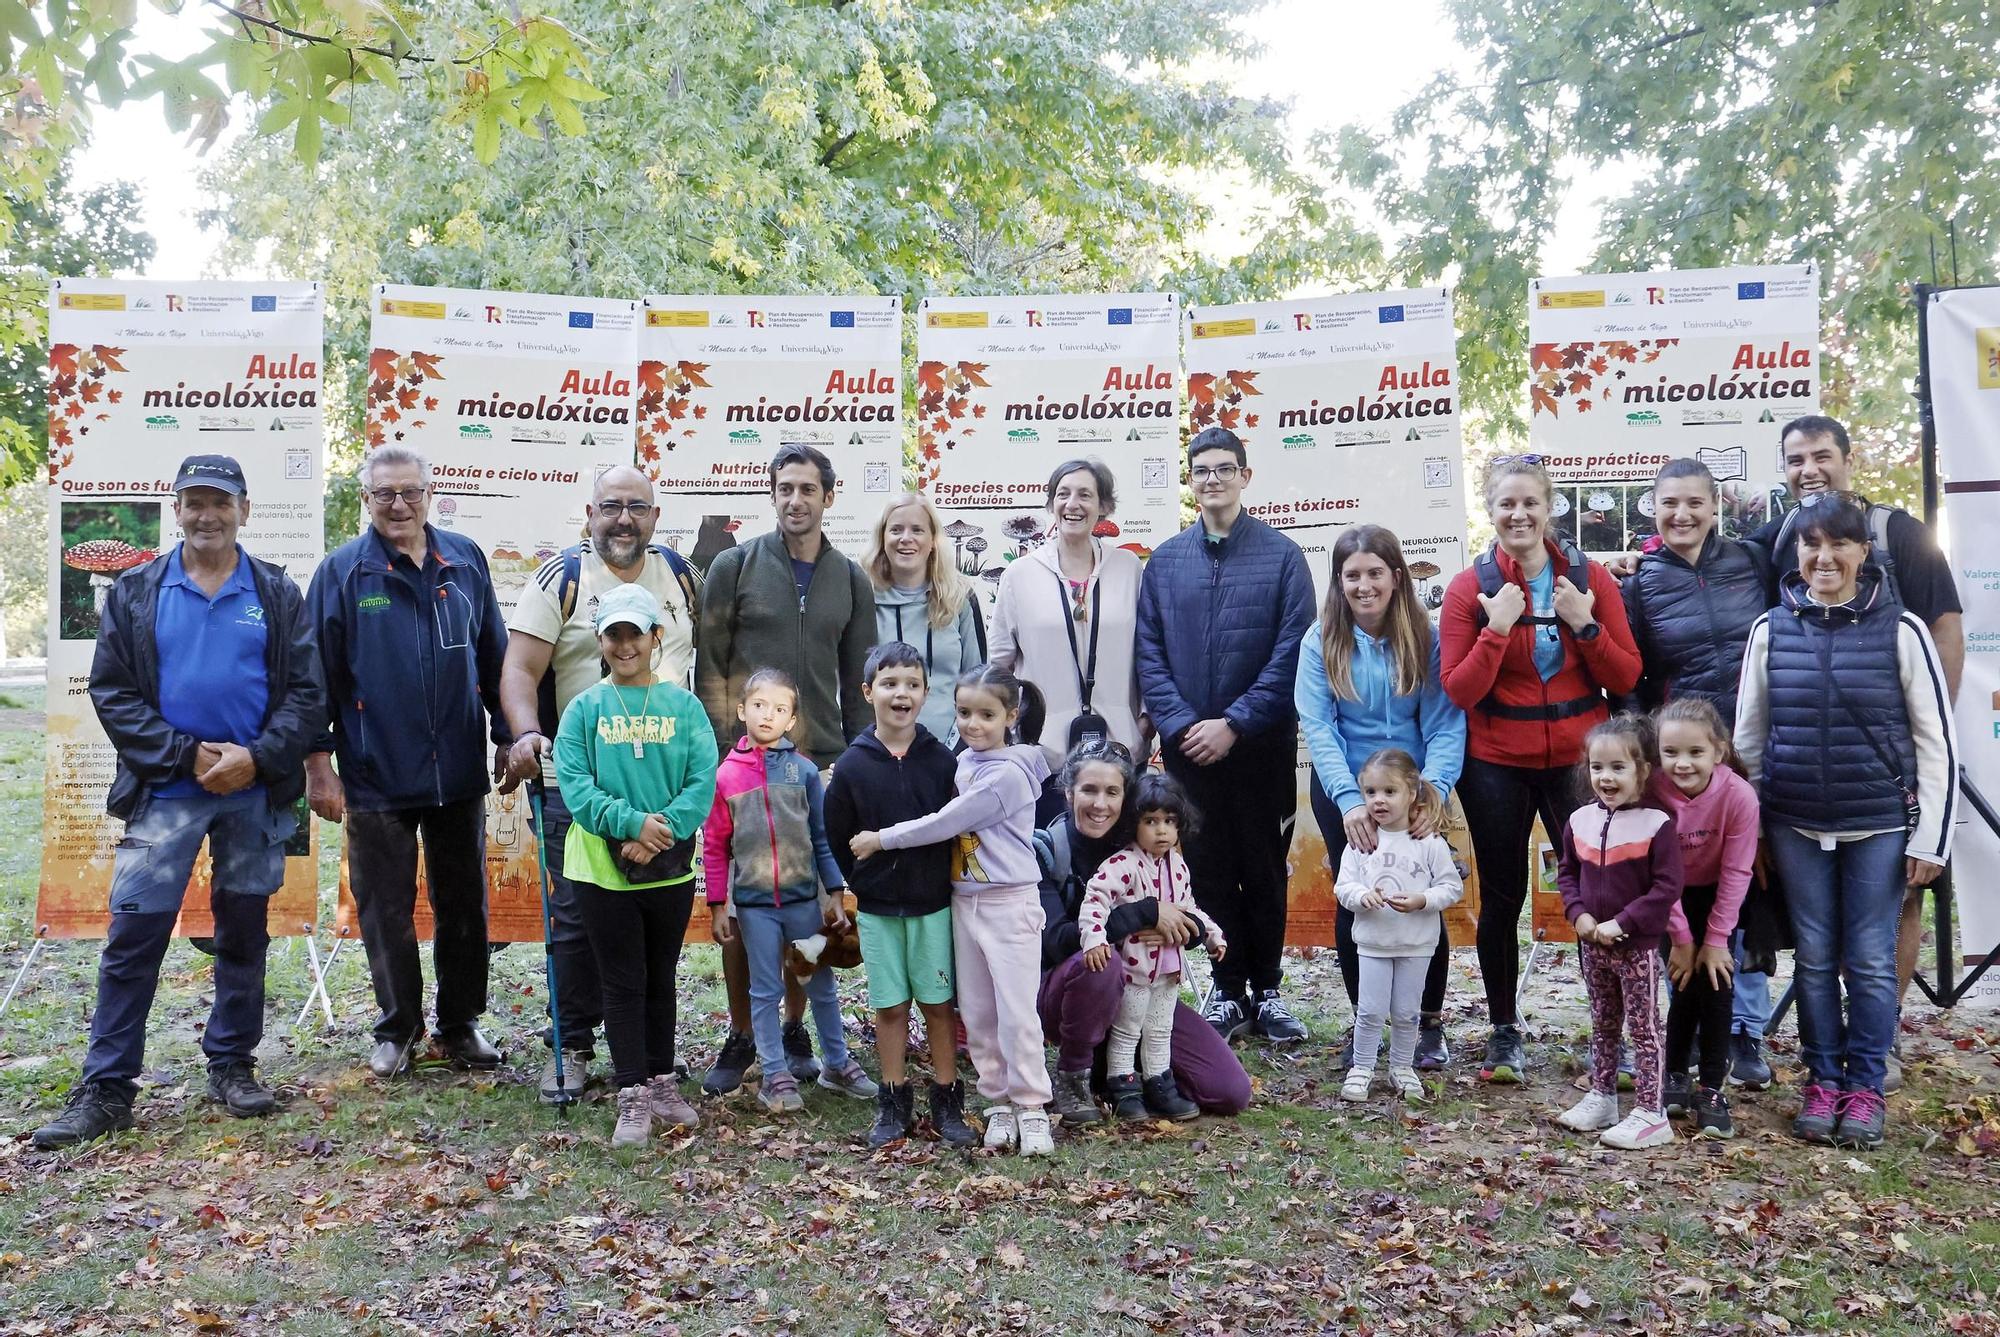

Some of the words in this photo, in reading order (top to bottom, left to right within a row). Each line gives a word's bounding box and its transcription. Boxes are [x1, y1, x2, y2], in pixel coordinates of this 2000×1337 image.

[125, 329, 154, 338] Montes
[1605, 324, 1634, 332] Montes
[444, 337, 472, 347] Montes
[709, 345, 736, 353] Montes
[988, 345, 1016, 353] Montes
[1257, 351, 1285, 359] Montes
[1732, 341, 1811, 370] Aula
[246, 353, 317, 379] Aula
[825, 369, 895, 394] Aula
[1103, 364, 1173, 391] Aula
[1378, 361, 1451, 391] Aula
[560, 369, 631, 397] Aula
[1623, 373, 1811, 404] micolóxica
[143, 382, 317, 408] micolóxica
[457, 392, 630, 424] micolóxica
[726, 396, 895, 423] micolóxica
[1004, 393, 1173, 421] micolóxica
[1278, 392, 1452, 428] micolóxica
[1586, 452, 1670, 469] prácticas
[432, 464, 482, 478] oloxía
[486, 470, 495, 478] e
[498, 467, 538, 482] ciclo
[541, 471, 579, 483] vital
[1569, 468, 1609, 479] apañar
[1611, 468, 1659, 479] cogomel
[62, 480, 94, 492] Que
[98, 481, 125, 491] son
[130, 481, 150, 491] os
[431, 481, 480, 491] gomelos
[659, 477, 720, 489] obtención
[722, 478, 737, 488] da
[740, 480, 771, 488] mate
[935, 481, 1003, 497] Especies
[1007, 484, 1049, 494] come
[945, 495, 1013, 506] confusións
[252, 502, 291, 510] formados
[293, 503, 307, 512] por
[1248, 502, 1290, 515] ecies
[1294, 498, 1360, 512] tóxicas:
[282, 531, 310, 539] núcleo
[1402, 536, 1459, 546] NEUROLÓXICA
[1301, 545, 1326, 553] ÓXICA
[1402, 547, 1437, 555] nterítica
[1963, 570, 2000, 579] Valore
[598, 715, 676, 739] GREEN
[63, 752, 90, 760] fungos
[80, 772, 110, 780] visibles
[60, 823, 93, 831] aspecto
[60, 834, 86, 842] Nacen
[88, 834, 112, 842] sobre
